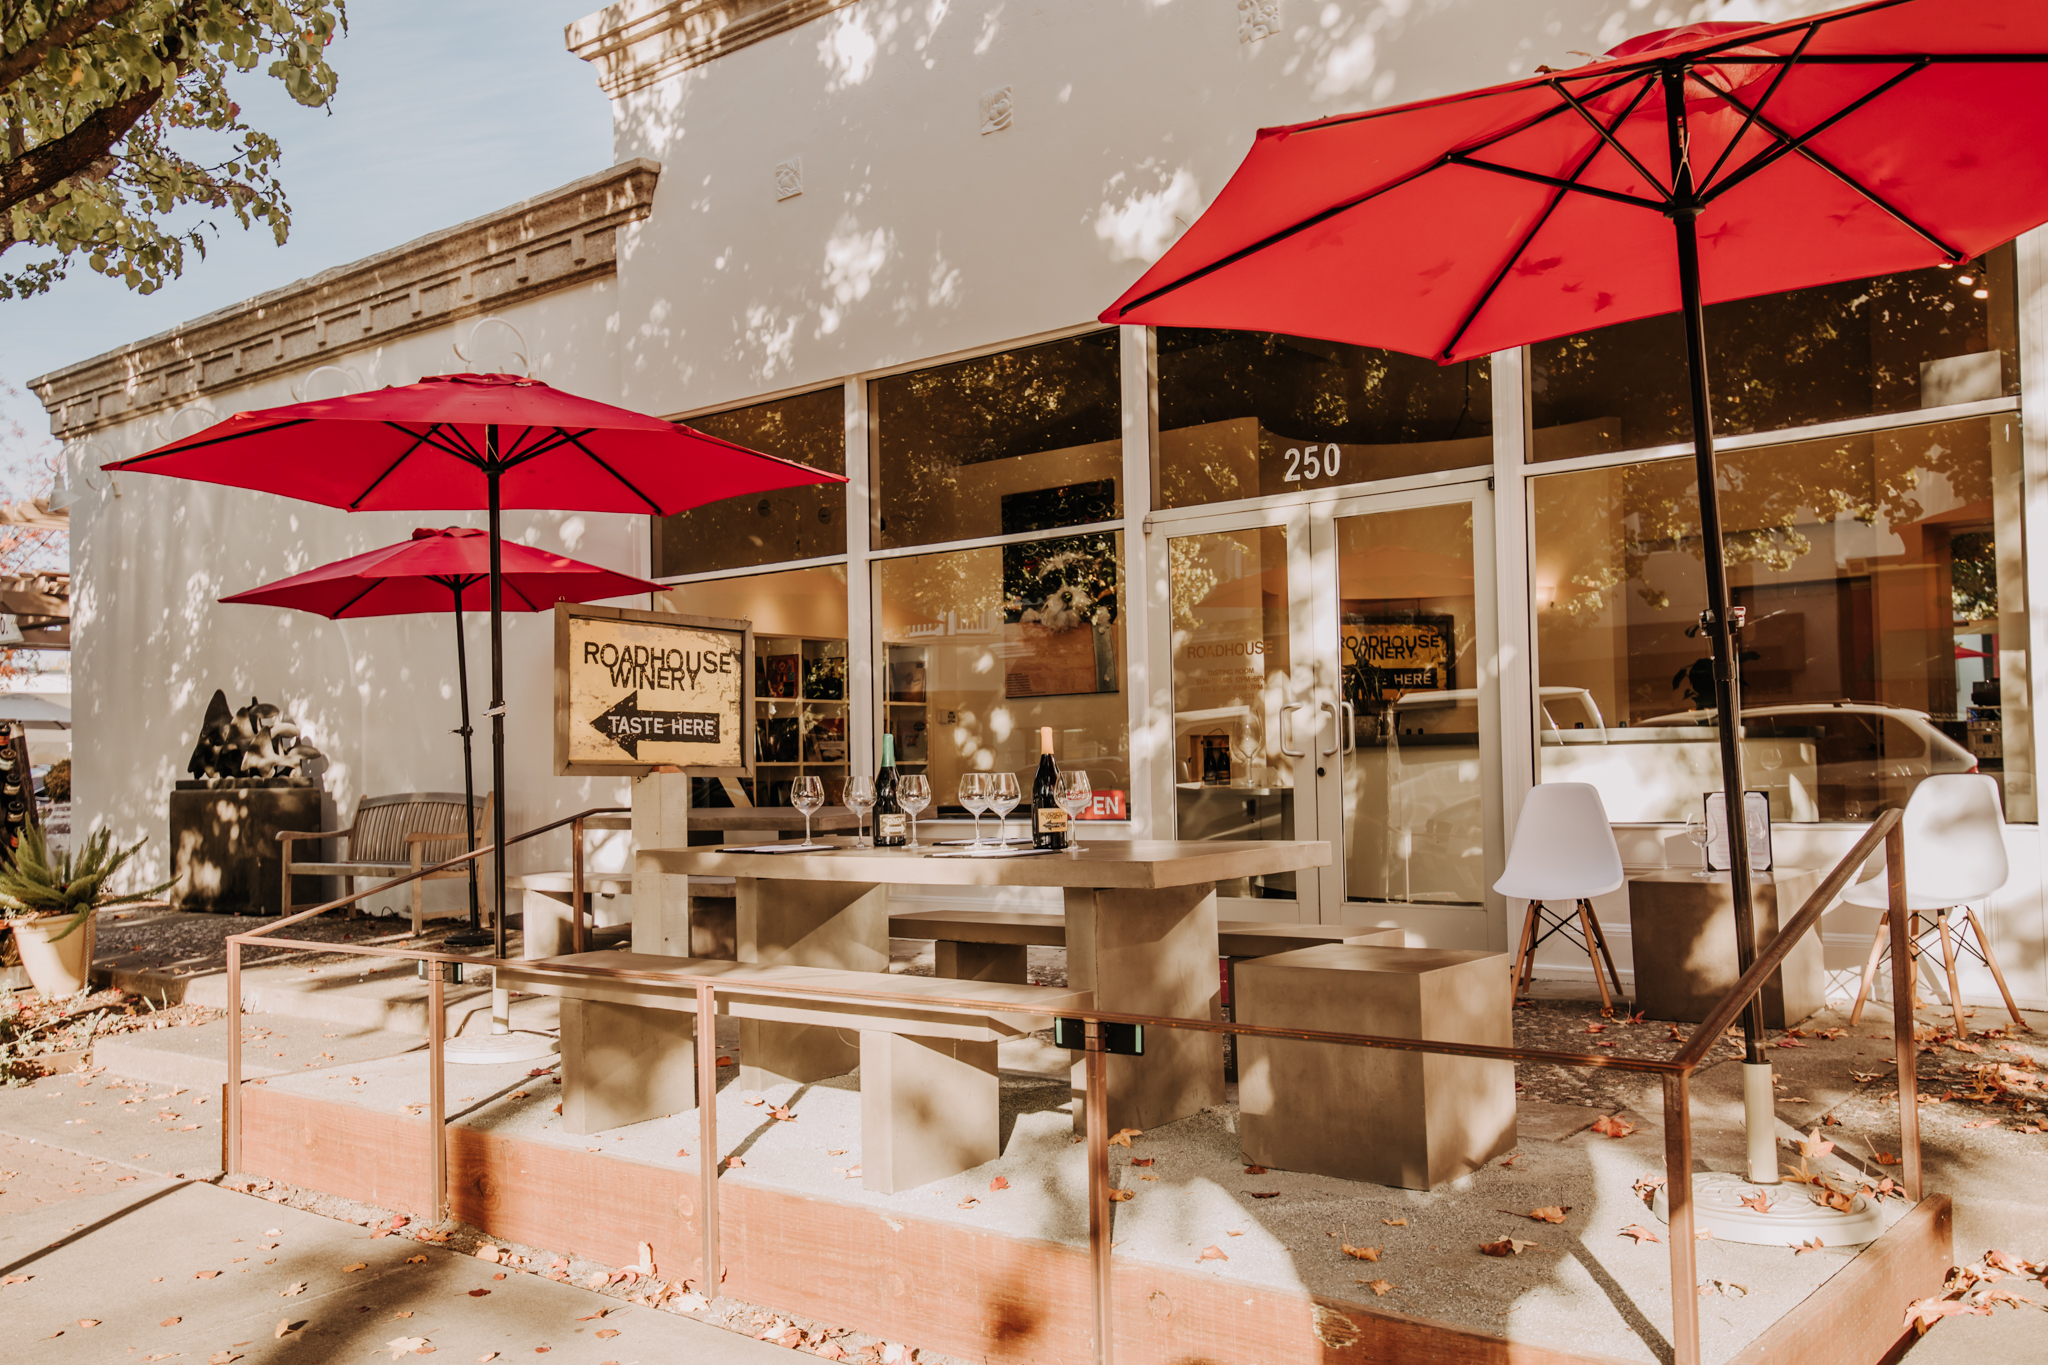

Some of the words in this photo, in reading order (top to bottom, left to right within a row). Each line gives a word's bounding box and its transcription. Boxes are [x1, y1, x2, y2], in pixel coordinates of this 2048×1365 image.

[1284, 443, 1341, 482] 250
[584, 641, 732, 674] ROADHOUSE
[1187, 640, 1273, 659] ROADHOUSE
[1352, 646, 1417, 660] WINERY
[609, 667, 701, 691] WINERY
[1394, 673, 1432, 685] HERE
[607, 716, 664, 735] TASTE
[671, 719, 714, 736] HERE
